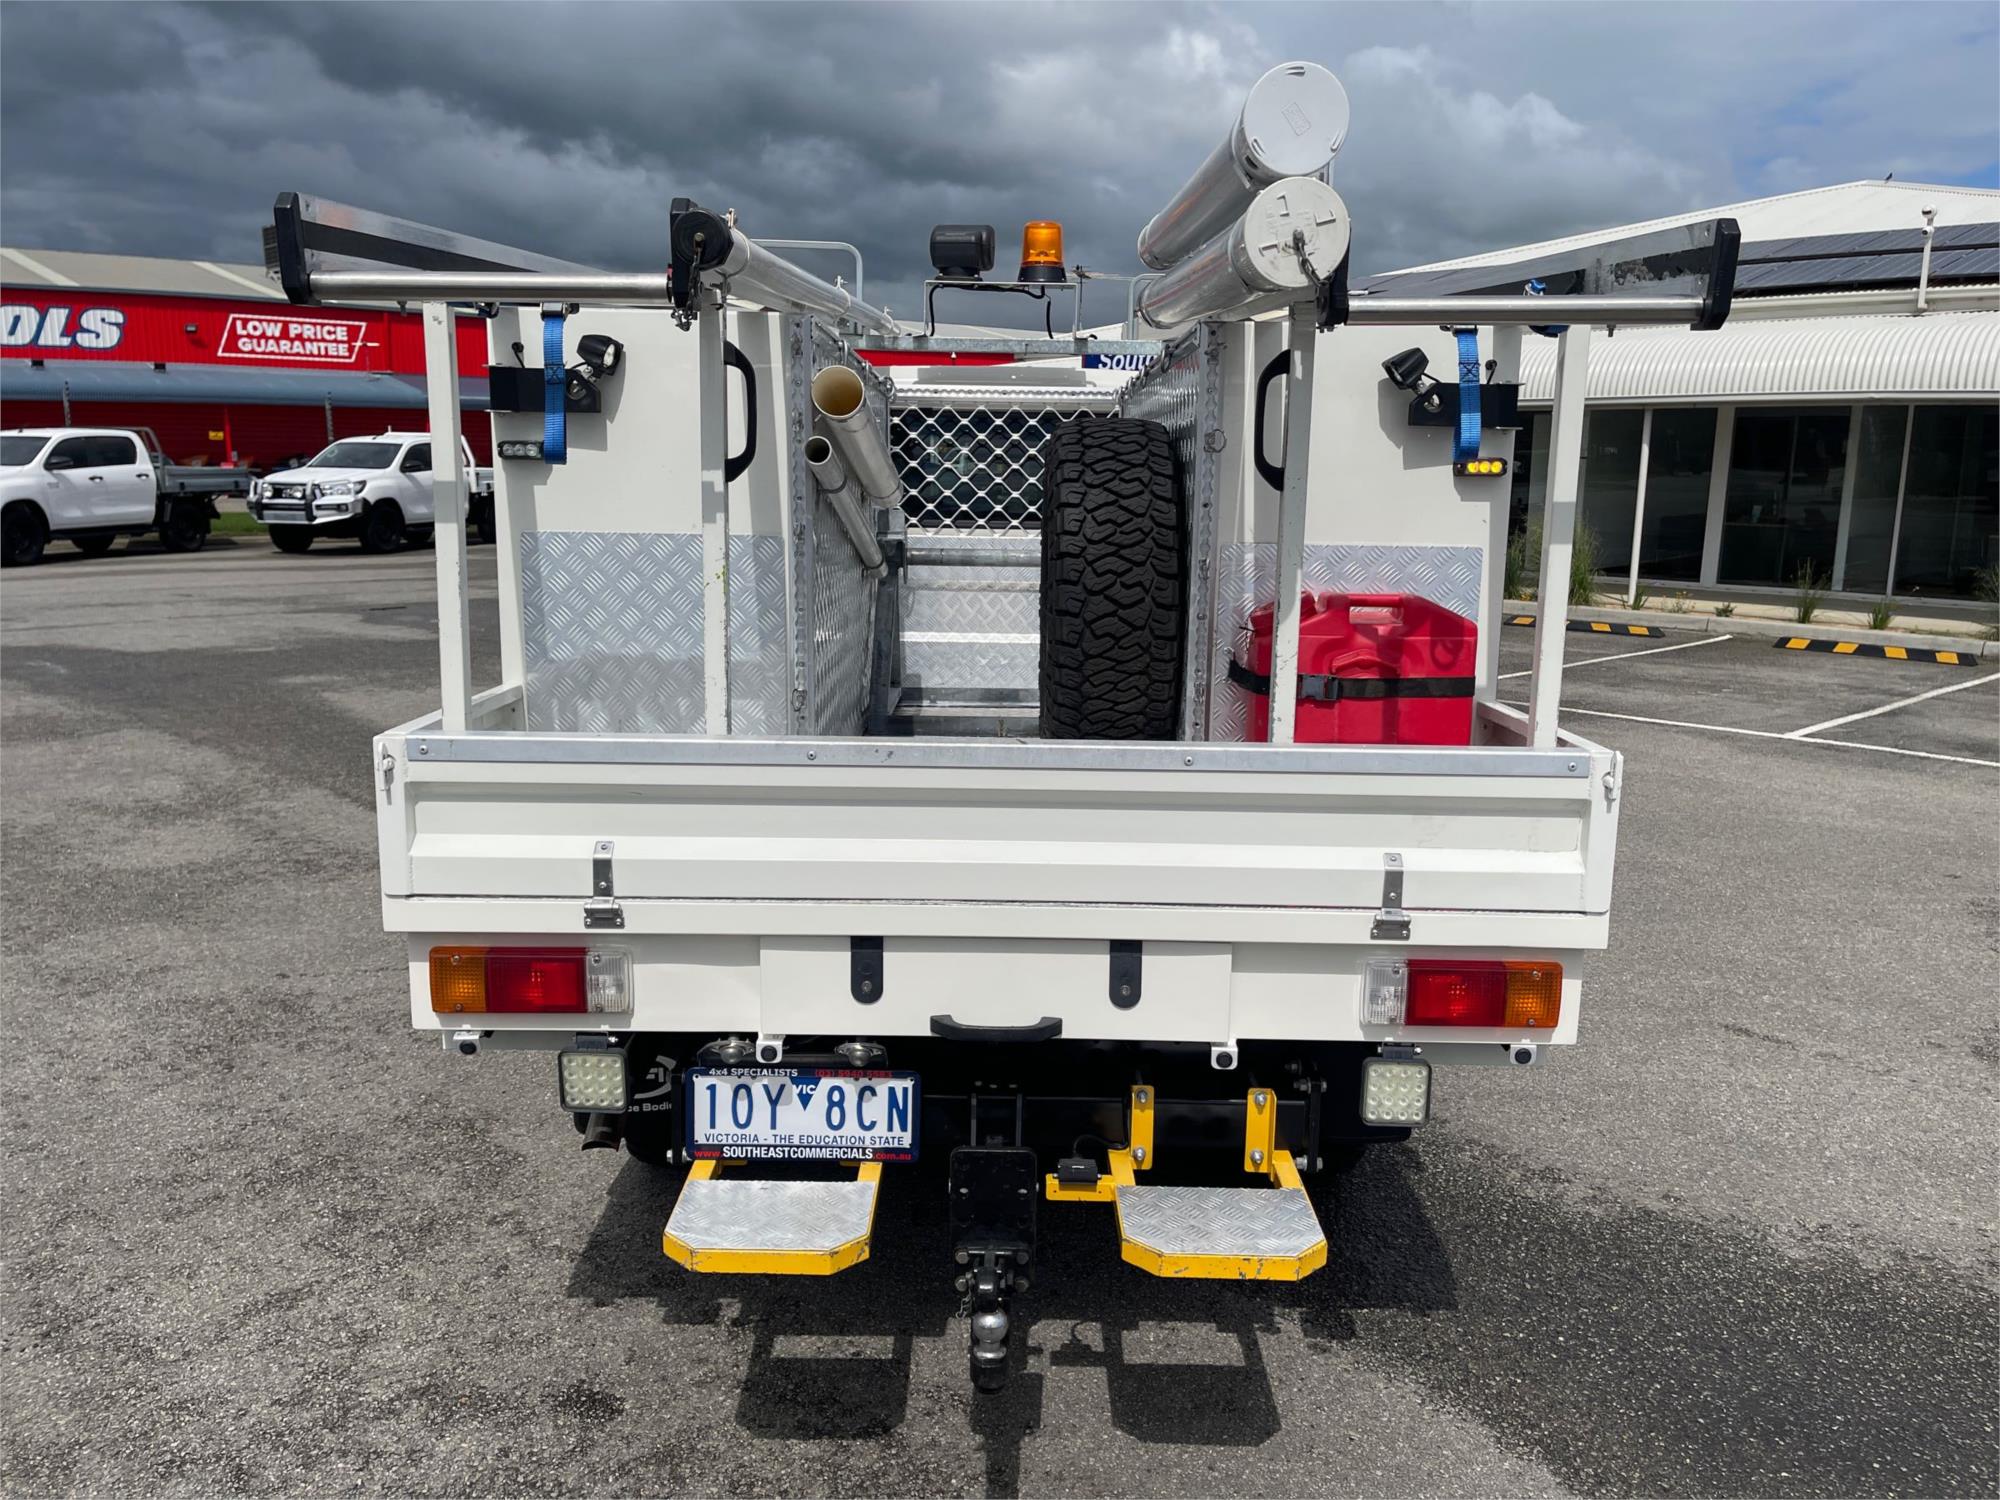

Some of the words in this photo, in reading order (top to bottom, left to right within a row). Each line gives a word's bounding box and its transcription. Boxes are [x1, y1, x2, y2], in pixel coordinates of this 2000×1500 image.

[0, 304, 125, 349] OLS
[235, 319, 282, 337] LOW
[288, 323, 348, 341] PRICE
[237, 337, 350, 357] GUARANTEE
[709, 1068, 728, 1076] 4x4
[730, 1068, 798, 1077] SPECIALISTS
[792, 1084, 816, 1095] VIC
[825, 1085, 909, 1133] 8CN
[704, 1133, 760, 1143] VICTORIA
[772, 1134, 794, 1144] THE
[798, 1135, 866, 1145] EDUCATION
[869, 1136, 904, 1146] STATE
